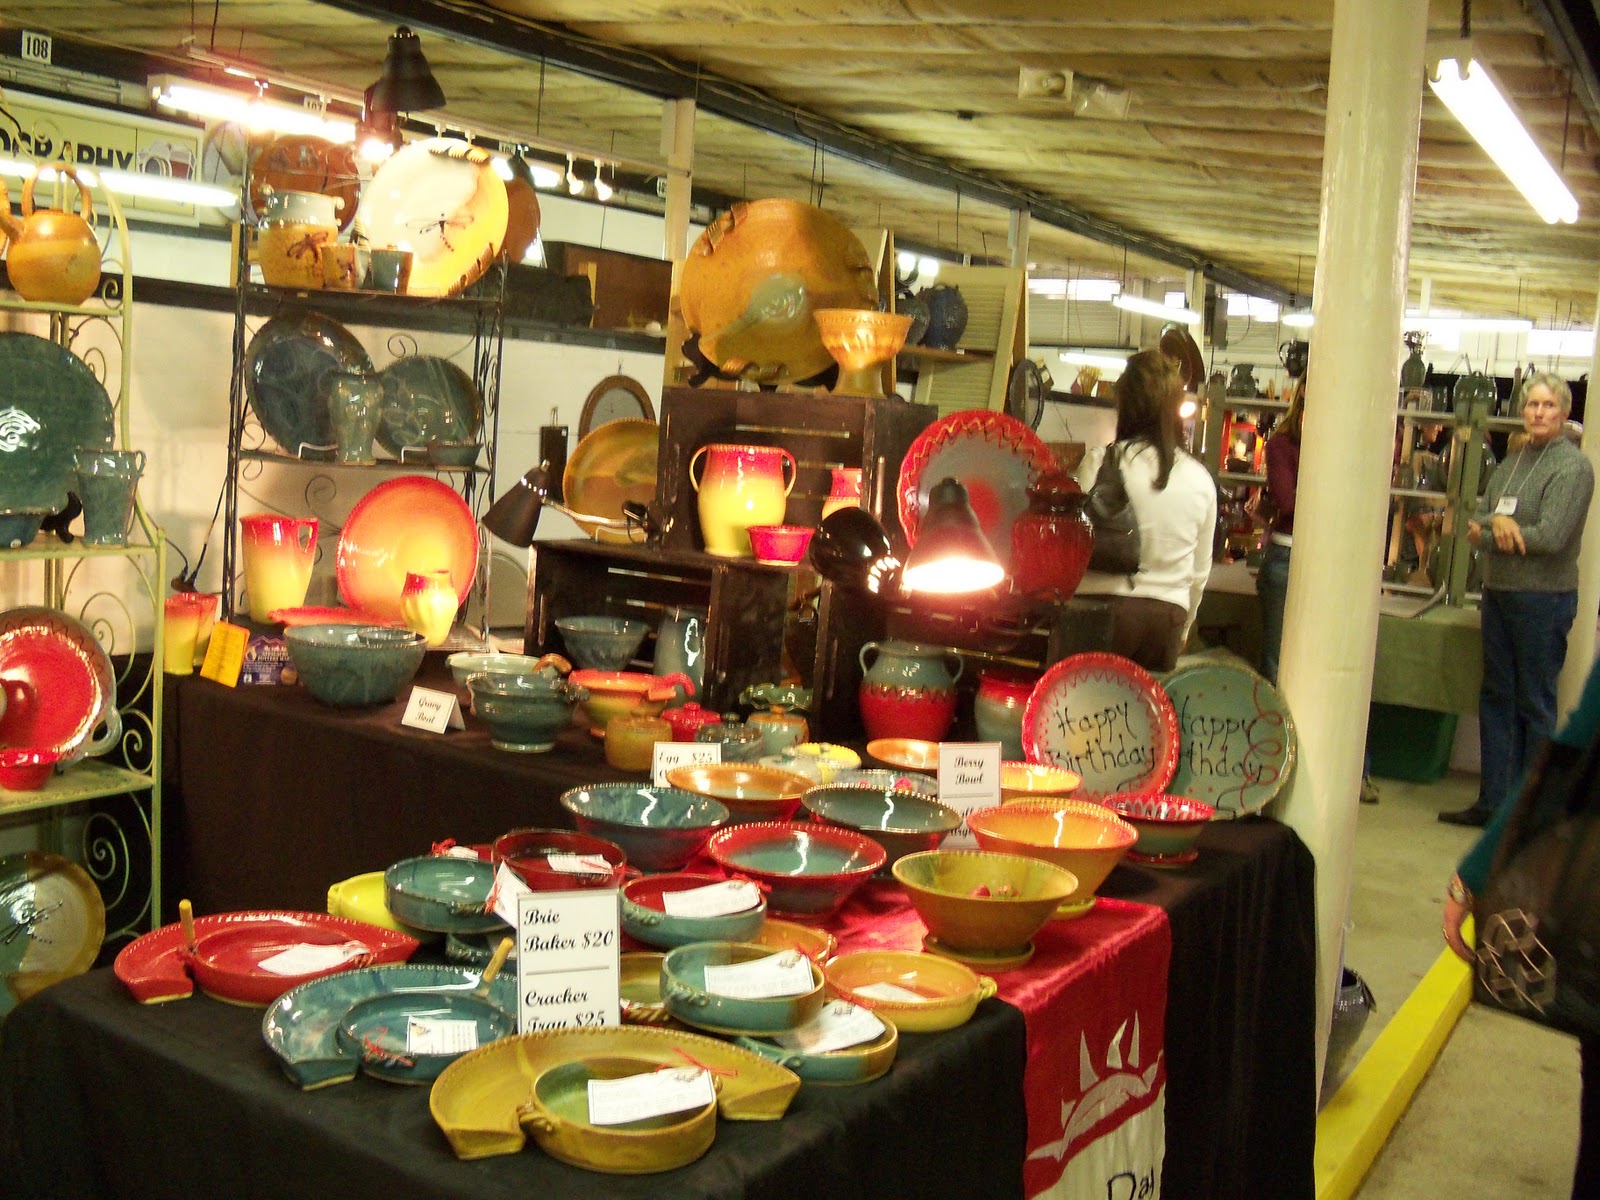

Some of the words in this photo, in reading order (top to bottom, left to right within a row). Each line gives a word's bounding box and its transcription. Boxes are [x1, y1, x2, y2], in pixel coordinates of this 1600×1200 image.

[26, 36, 49, 59] 108
[1056, 702, 1137, 743] Happy
[659, 751, 680, 765] Egg
[692, 752, 713, 764] $25
[954, 757, 984, 770] Berry
[955, 773, 984, 785] Bowl
[523, 909, 560, 926] Brie
[524, 934, 577, 953] Baker
[581, 929, 614, 951] $20
[525, 987, 589, 1007] Cracker
[573, 1010, 605, 1029] $25
